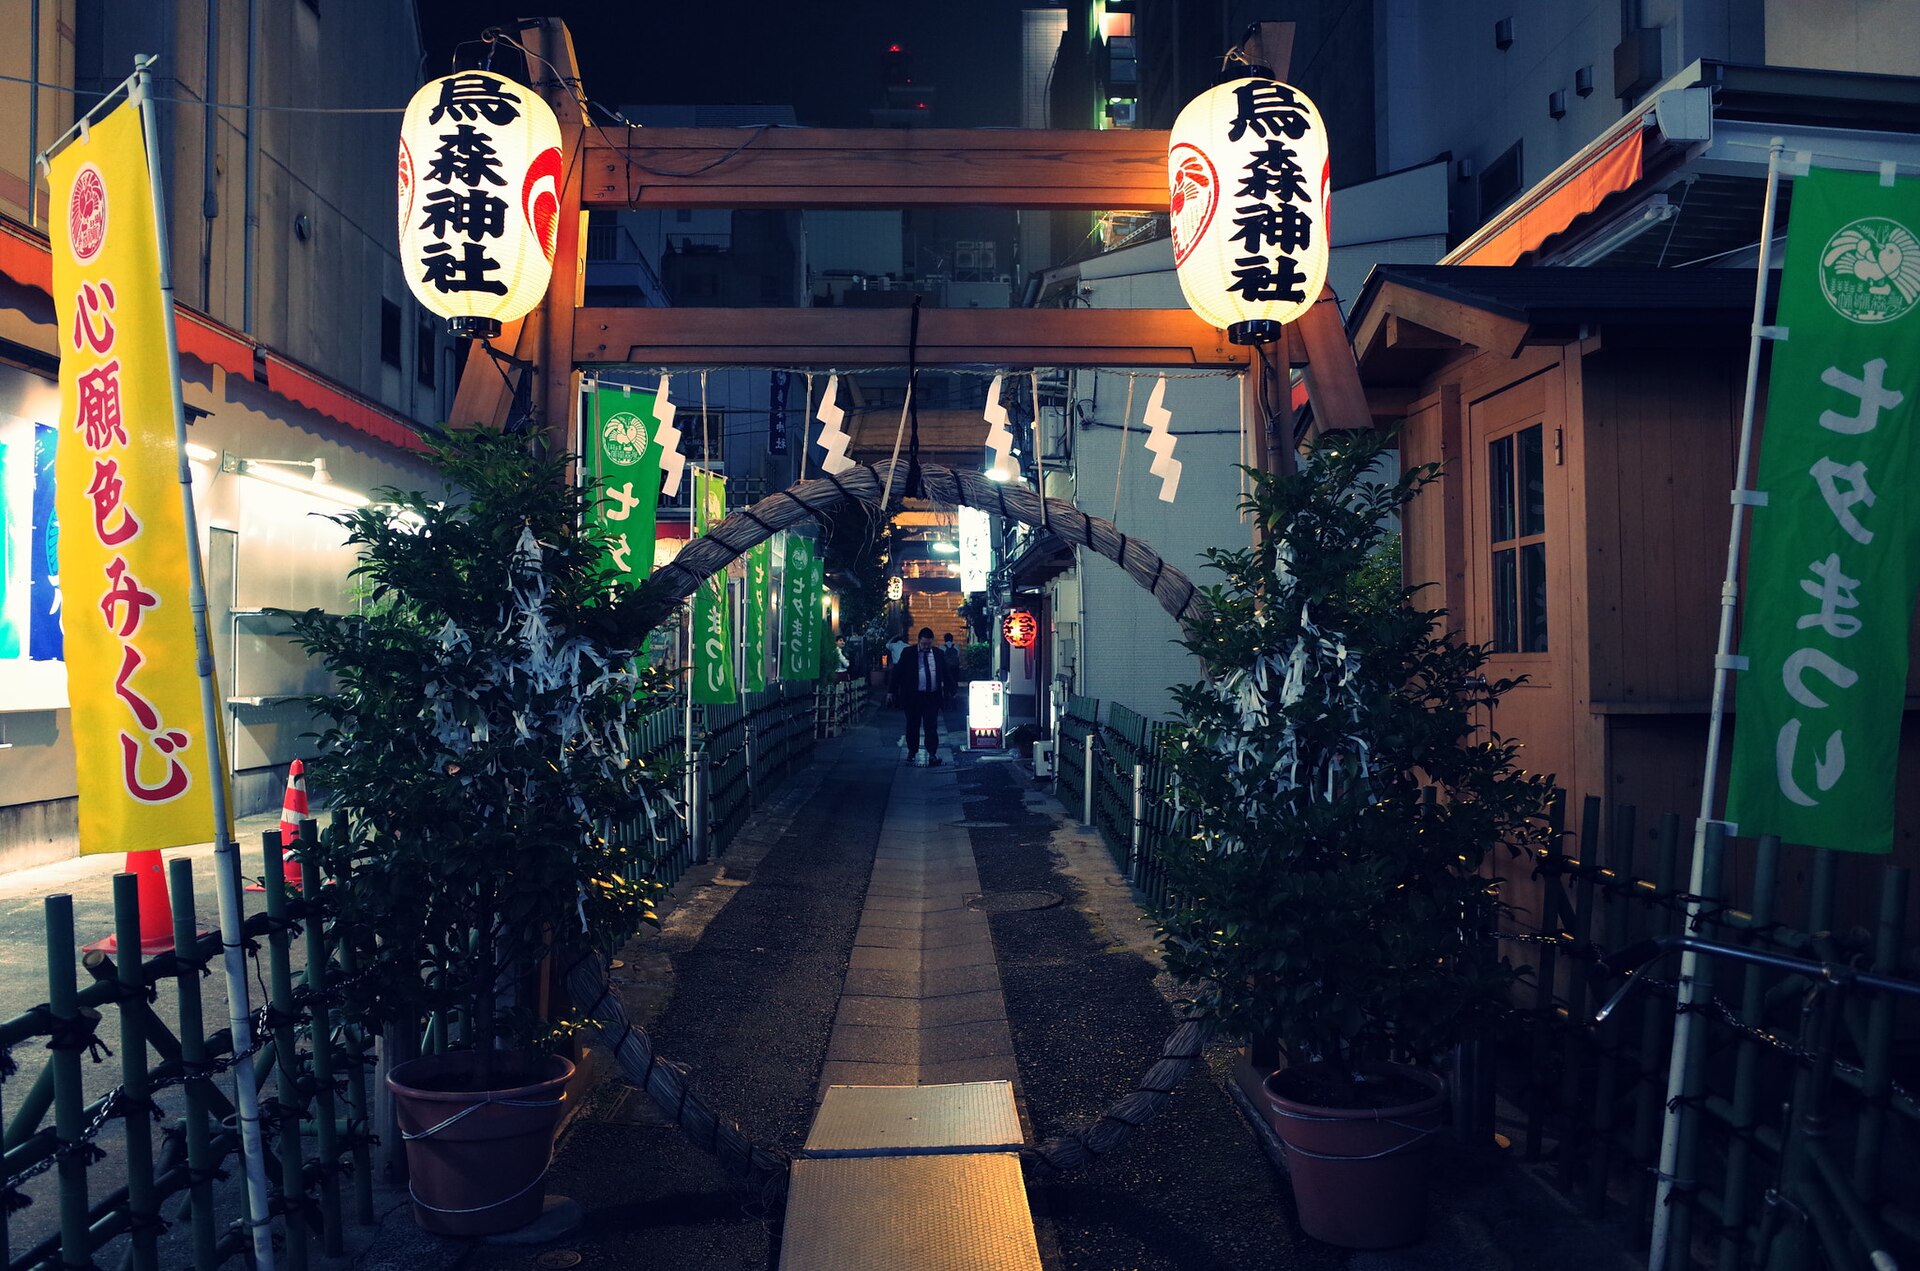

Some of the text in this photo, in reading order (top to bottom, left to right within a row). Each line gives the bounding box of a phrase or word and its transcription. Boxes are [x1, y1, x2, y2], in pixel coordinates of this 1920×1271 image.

[74, 283, 189, 799] 心願色みくじ
